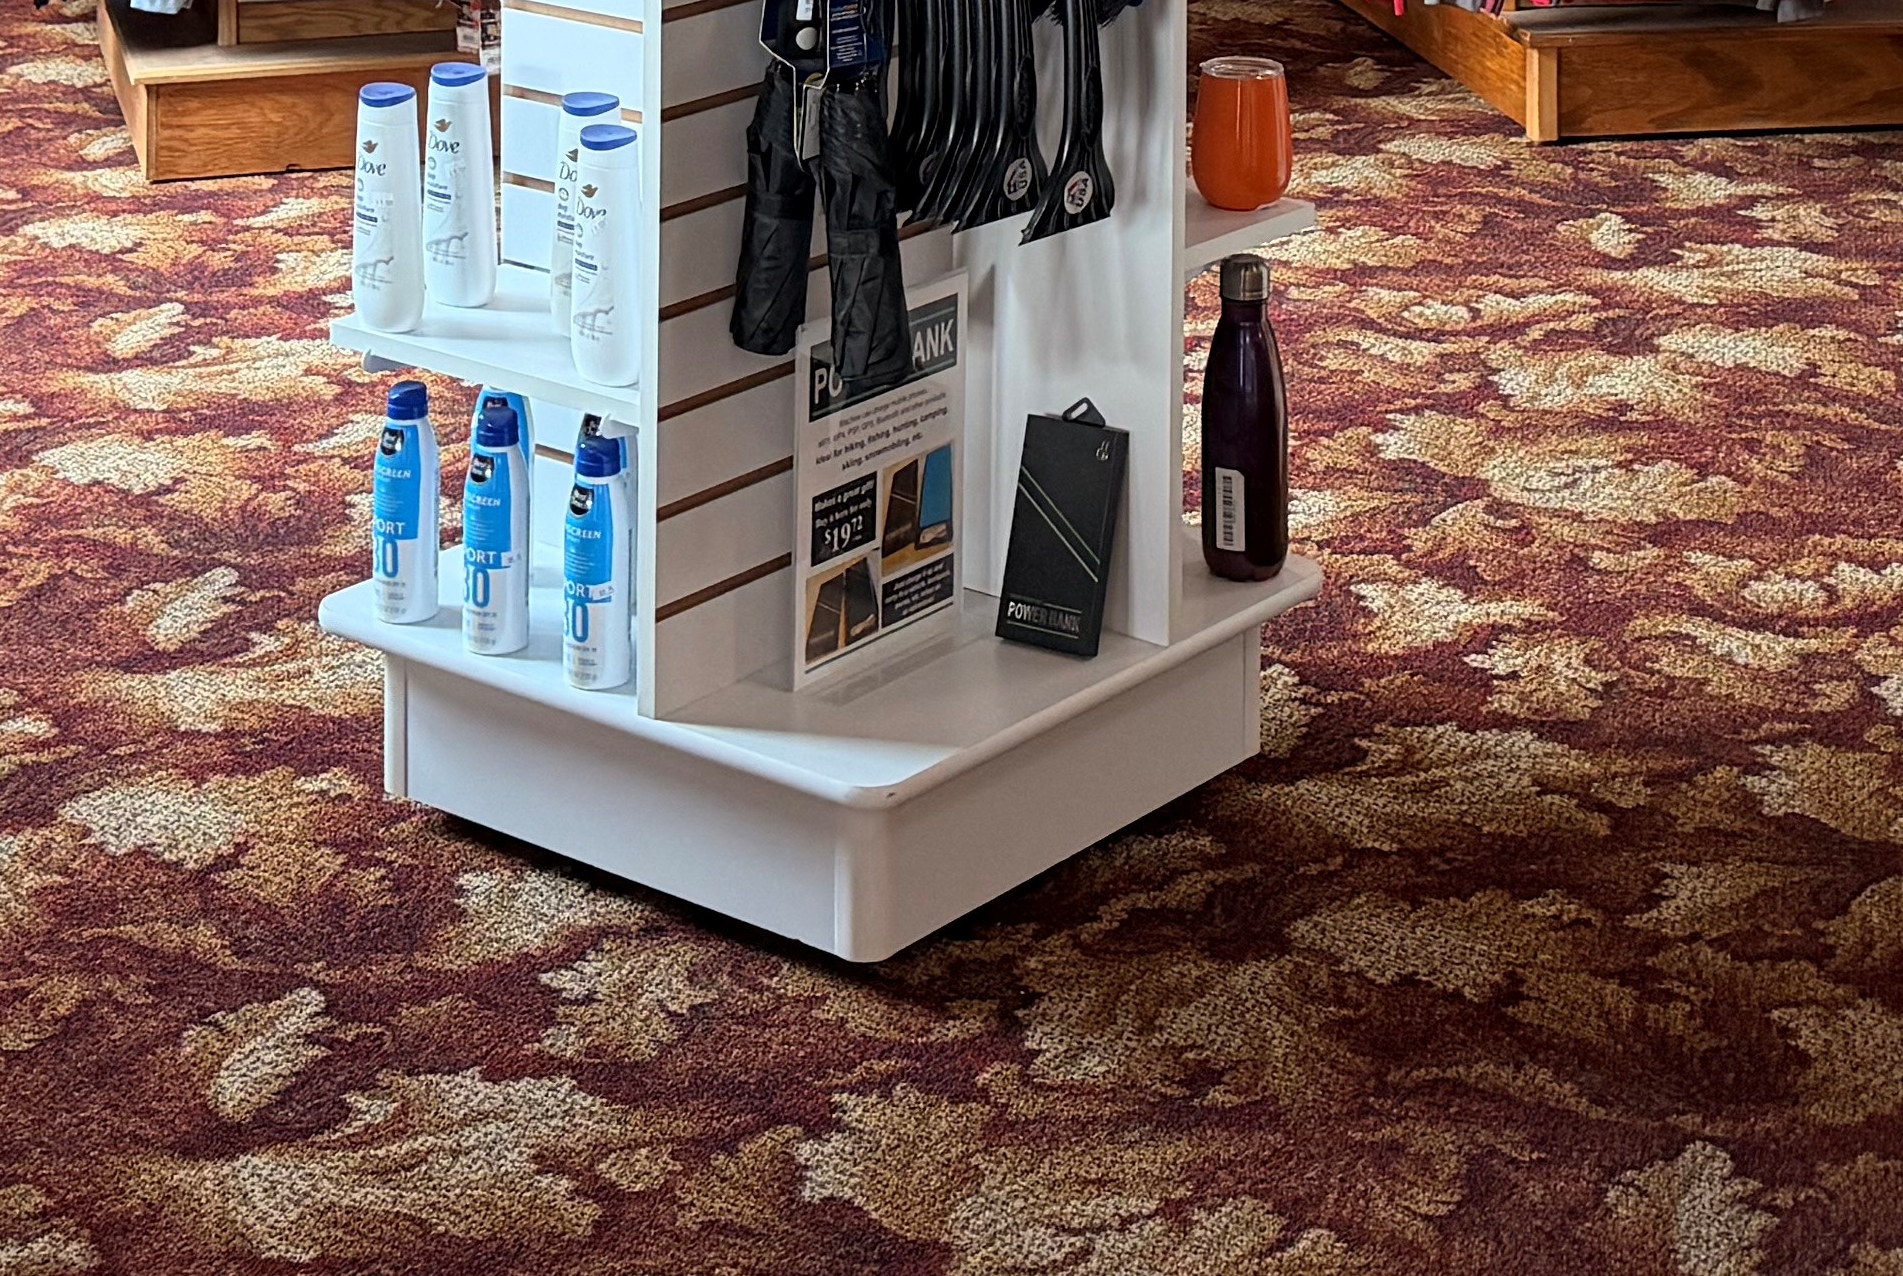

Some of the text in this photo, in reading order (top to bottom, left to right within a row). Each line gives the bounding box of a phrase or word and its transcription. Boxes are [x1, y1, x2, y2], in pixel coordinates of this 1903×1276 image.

[428, 132, 461, 155] Dove
[357, 155, 387, 177] Dove
[1008, 601, 1081, 634] POWER BANK
